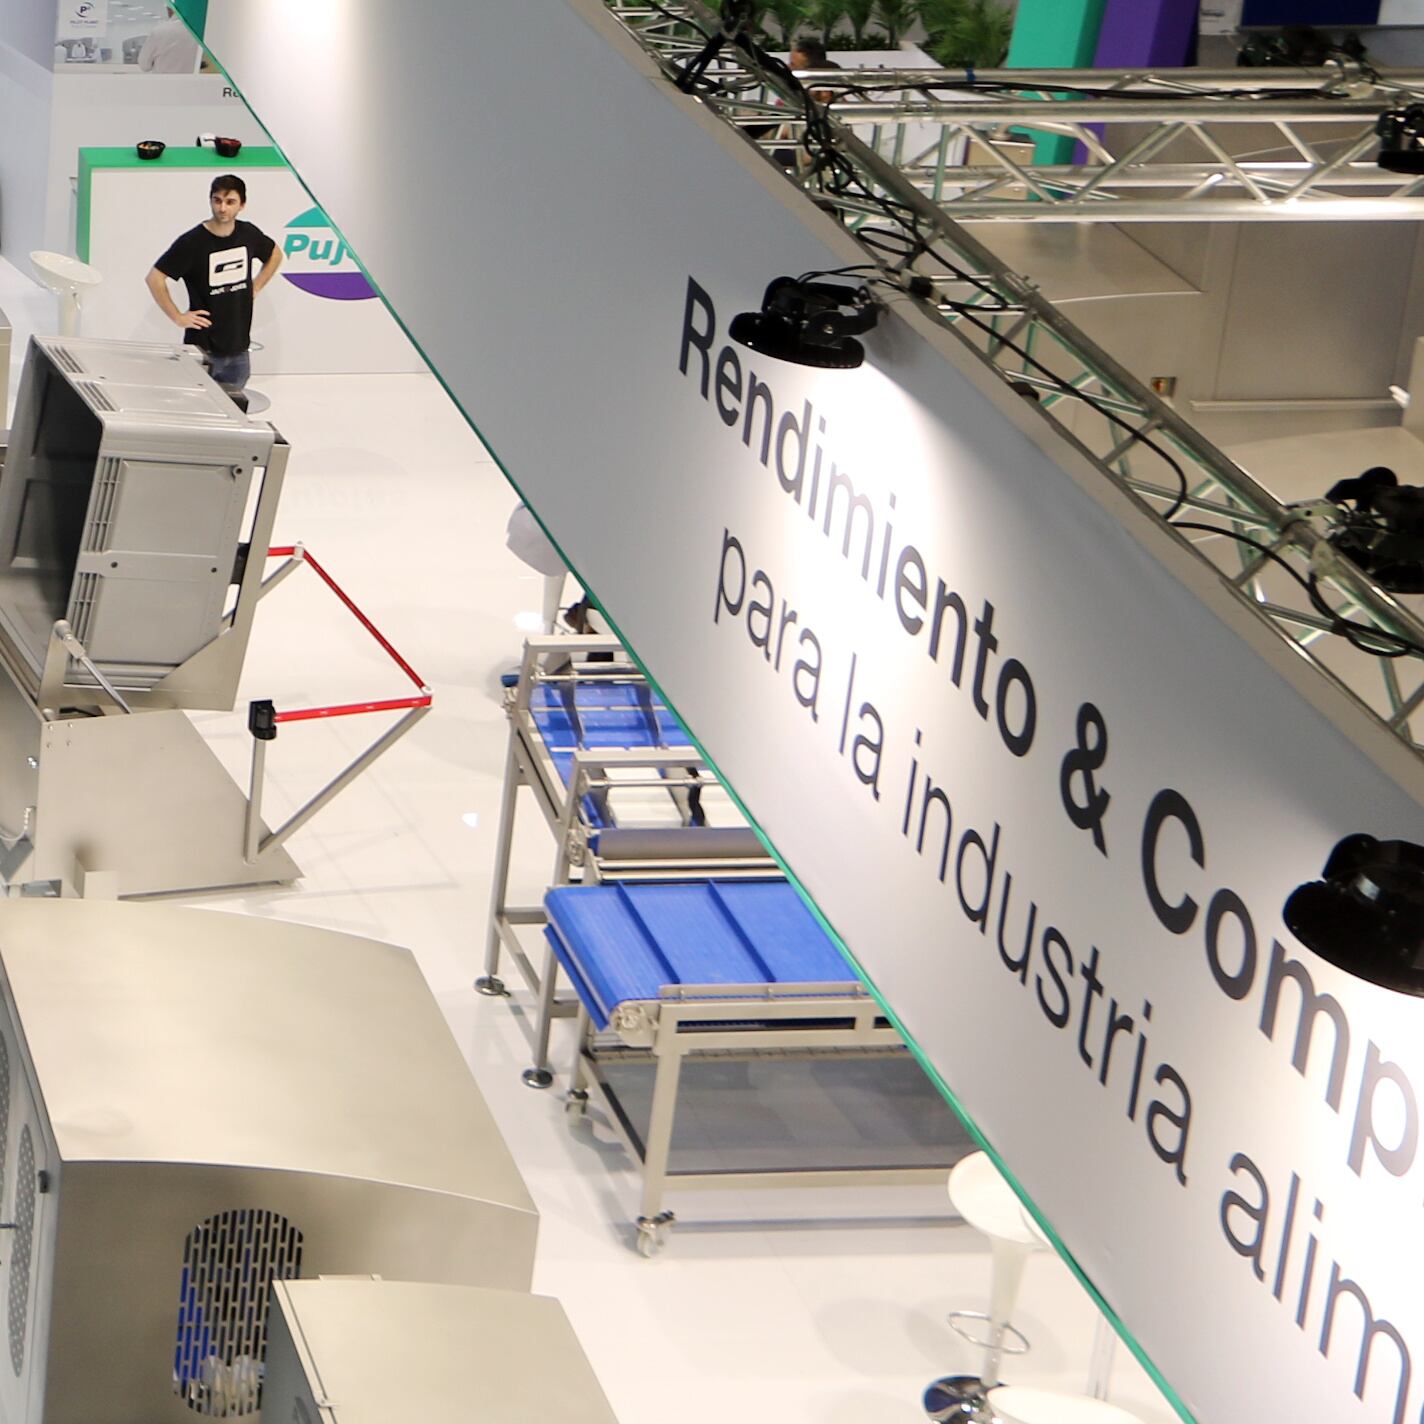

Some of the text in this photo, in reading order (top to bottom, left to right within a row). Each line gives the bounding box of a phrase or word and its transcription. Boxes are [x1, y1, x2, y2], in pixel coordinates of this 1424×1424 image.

[678, 273, 1424, 1206] Rendimiento & Comp
[714, 526, 1424, 1416] para la industria alim
